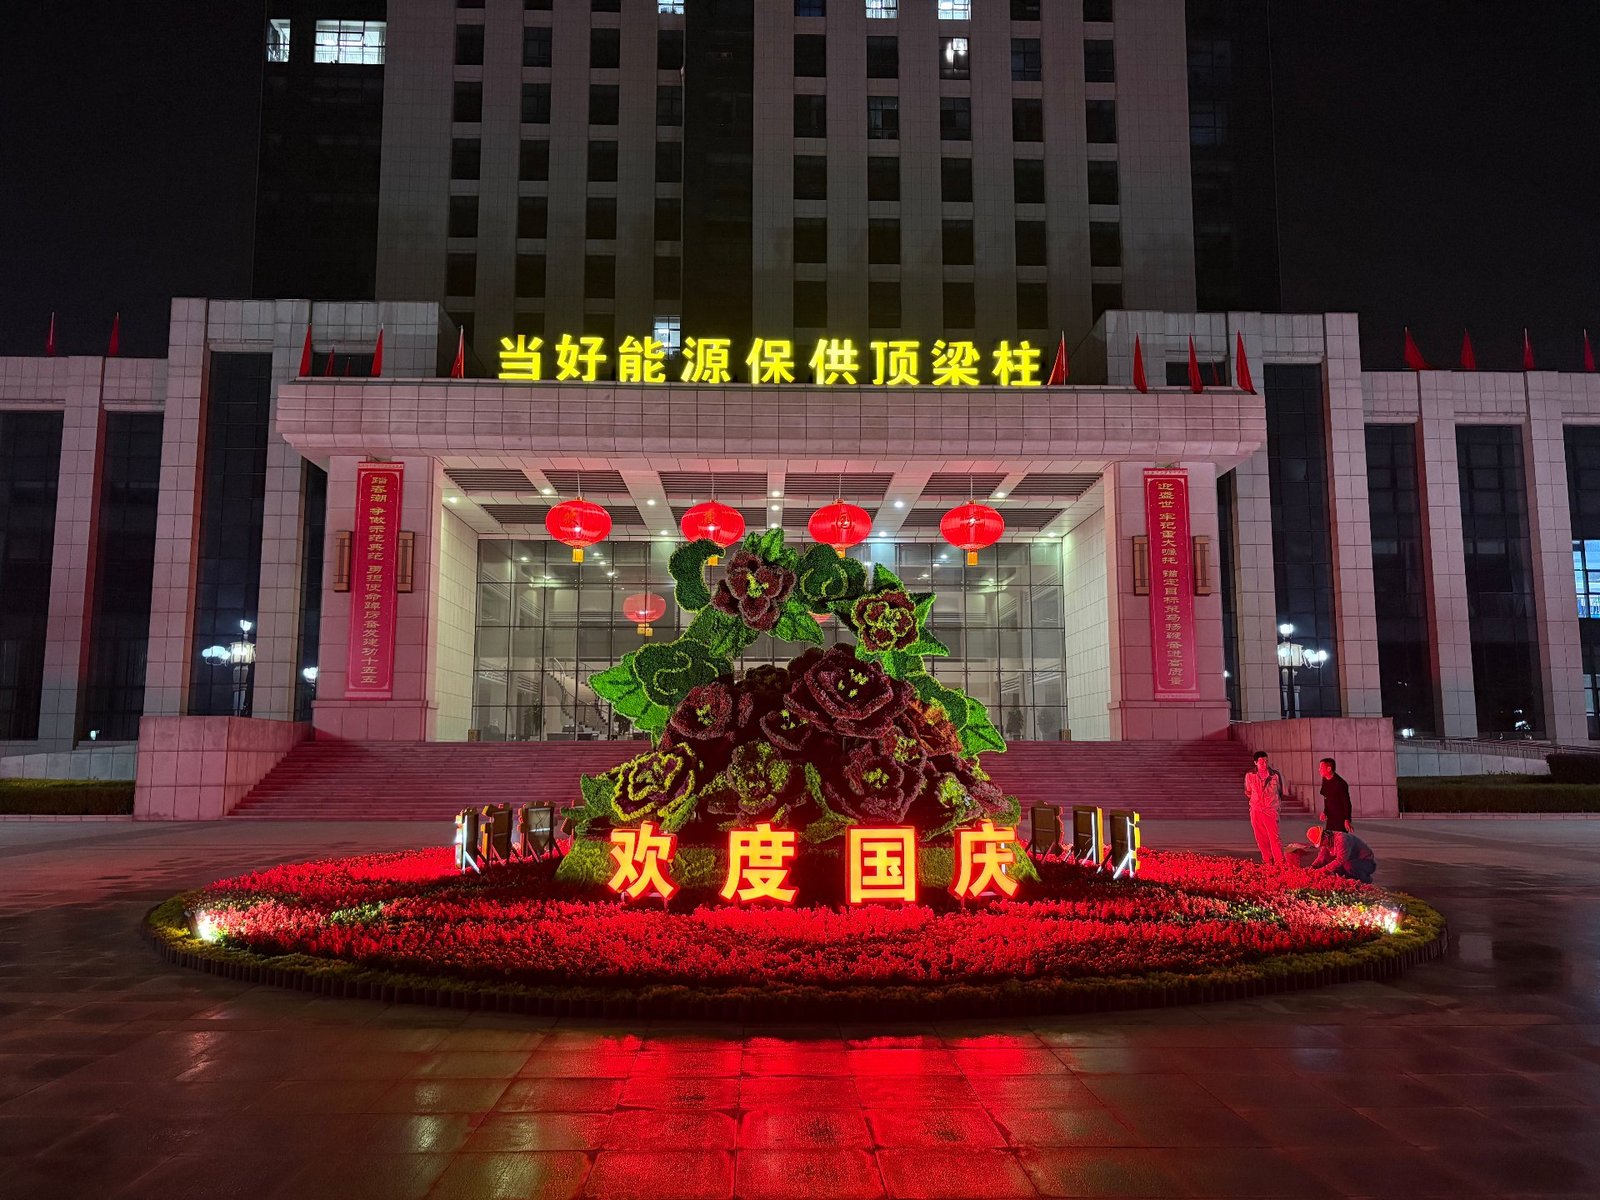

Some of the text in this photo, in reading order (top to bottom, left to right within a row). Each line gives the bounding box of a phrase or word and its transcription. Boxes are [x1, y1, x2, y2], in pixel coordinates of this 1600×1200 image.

[498, 334, 1042, 387] 当好能源保供顶梁柱
[607, 821, 1020, 904] 欢度国庆
